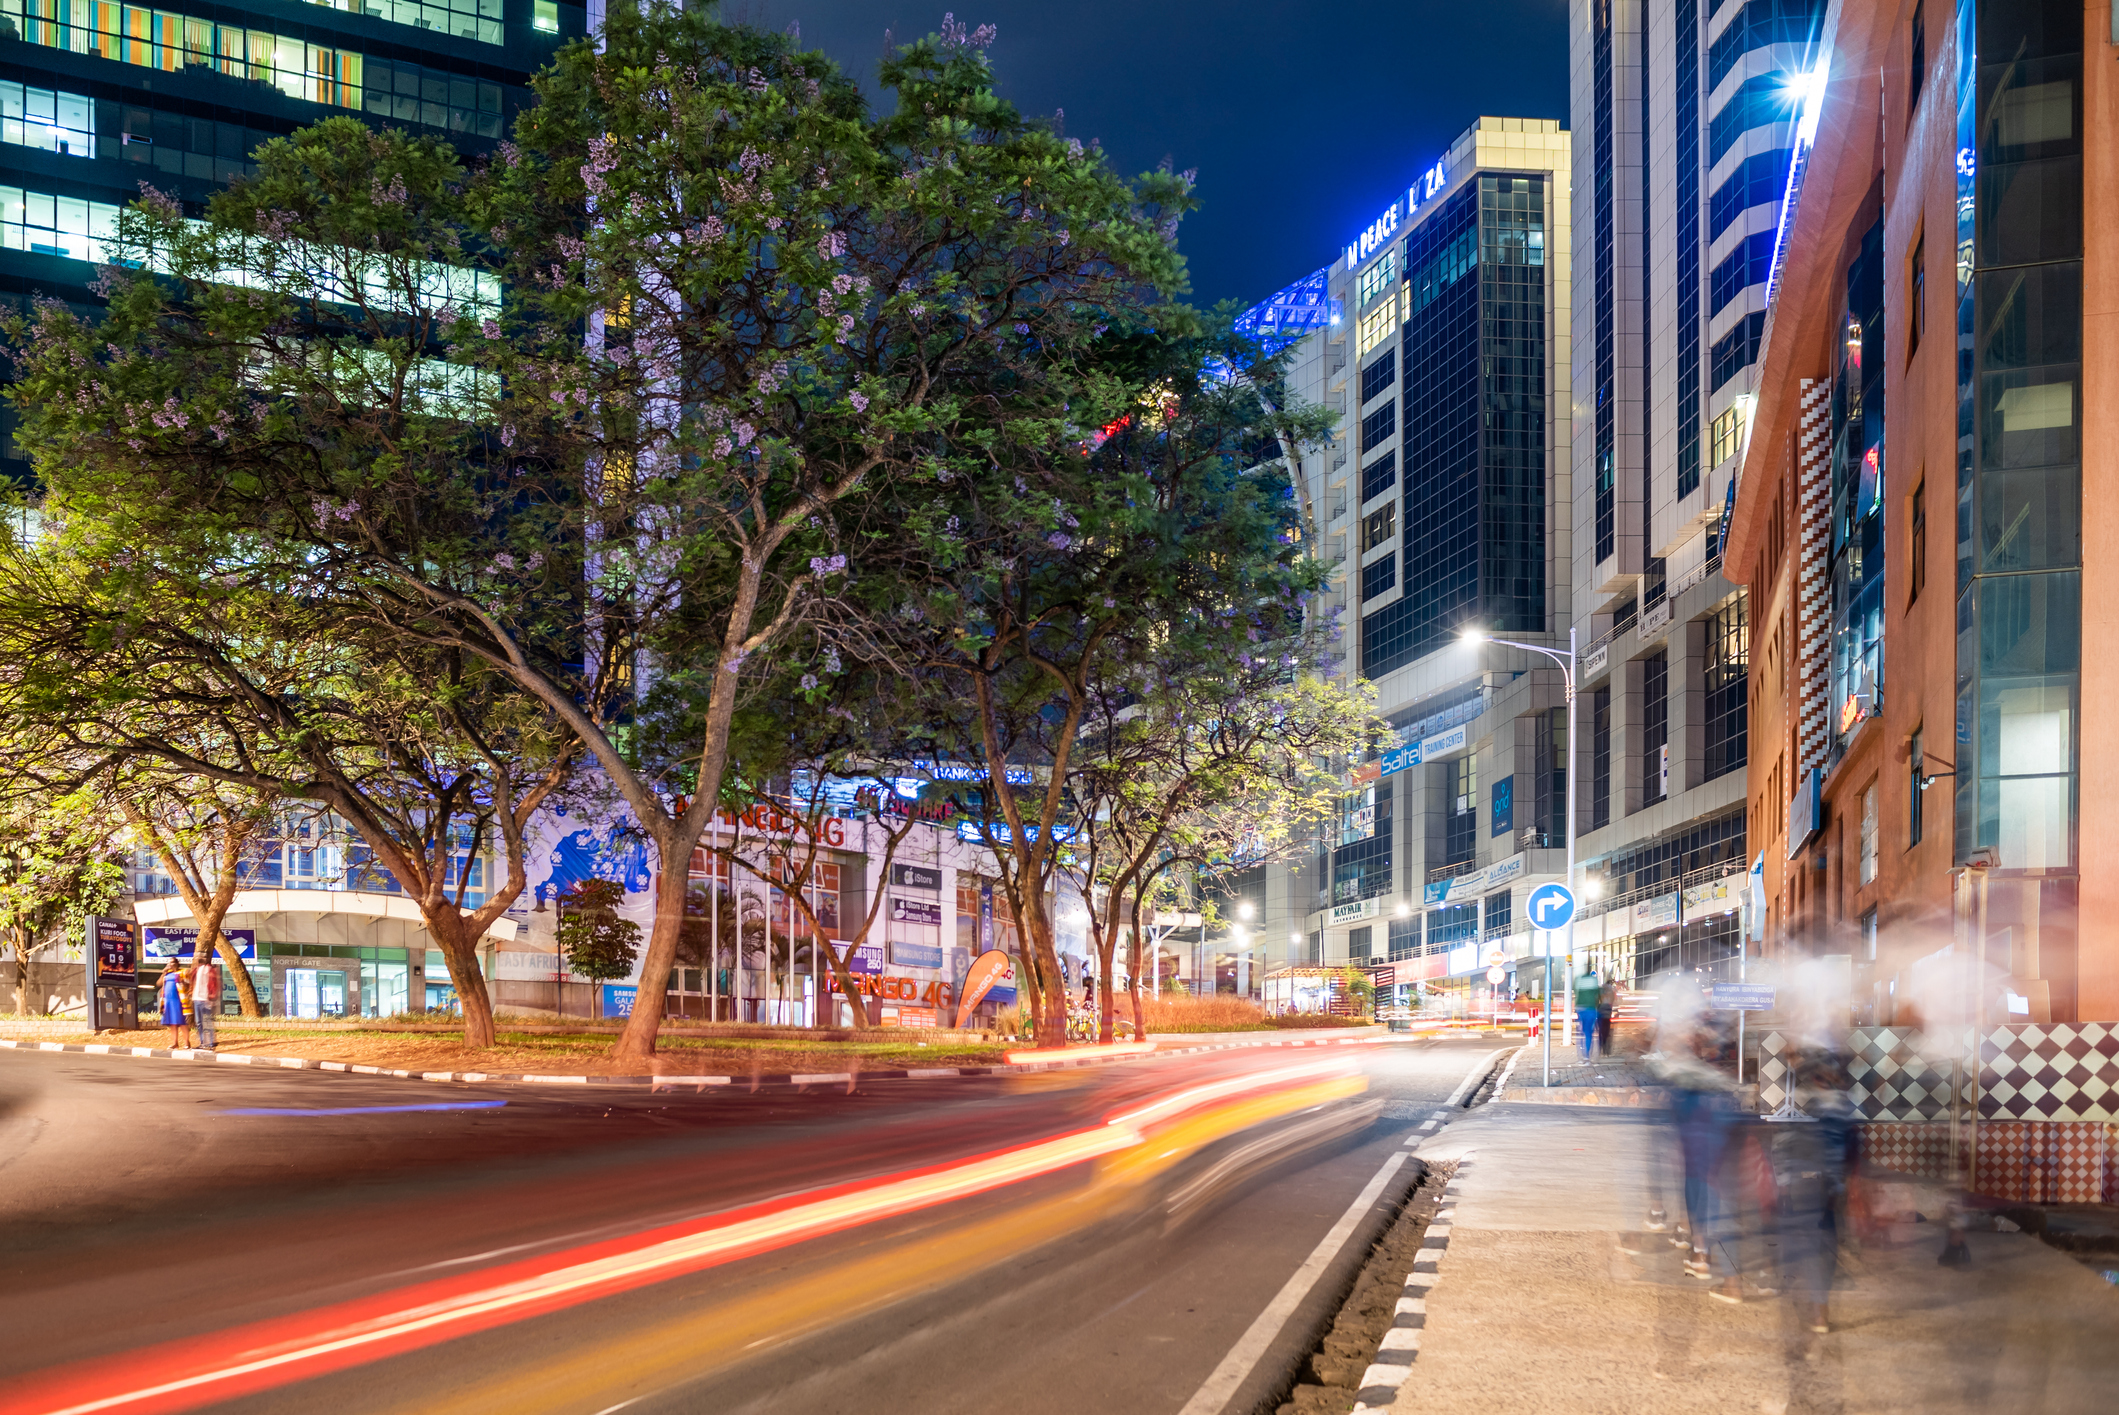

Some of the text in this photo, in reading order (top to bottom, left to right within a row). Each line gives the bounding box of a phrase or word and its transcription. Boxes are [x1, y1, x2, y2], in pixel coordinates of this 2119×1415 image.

[1347, 240, 1358, 271] M
[1360, 203, 1398, 259] PEACE
[1424, 731, 1464, 756] TRAINING CENTER
[1381, 743, 1421, 774] Saltel
[1494, 789, 1511, 818] grid
[914, 873, 933, 885] iStore
[1489, 859, 1520, 880] ALLIANCE
[905, 900, 921, 911] iStore
[1333, 902, 1362, 917] MAYFAIR
[905, 910, 922, 921] Samsung
[922, 912, 932, 923] Store
[273, 958, 299, 966] NORTH
[896, 948, 940, 963] SAMSUNG STORE
[823, 970, 917, 1000] MANGO
[921, 981, 952, 1010] 4G
[963, 962, 1003, 1011] MANGO 4G
